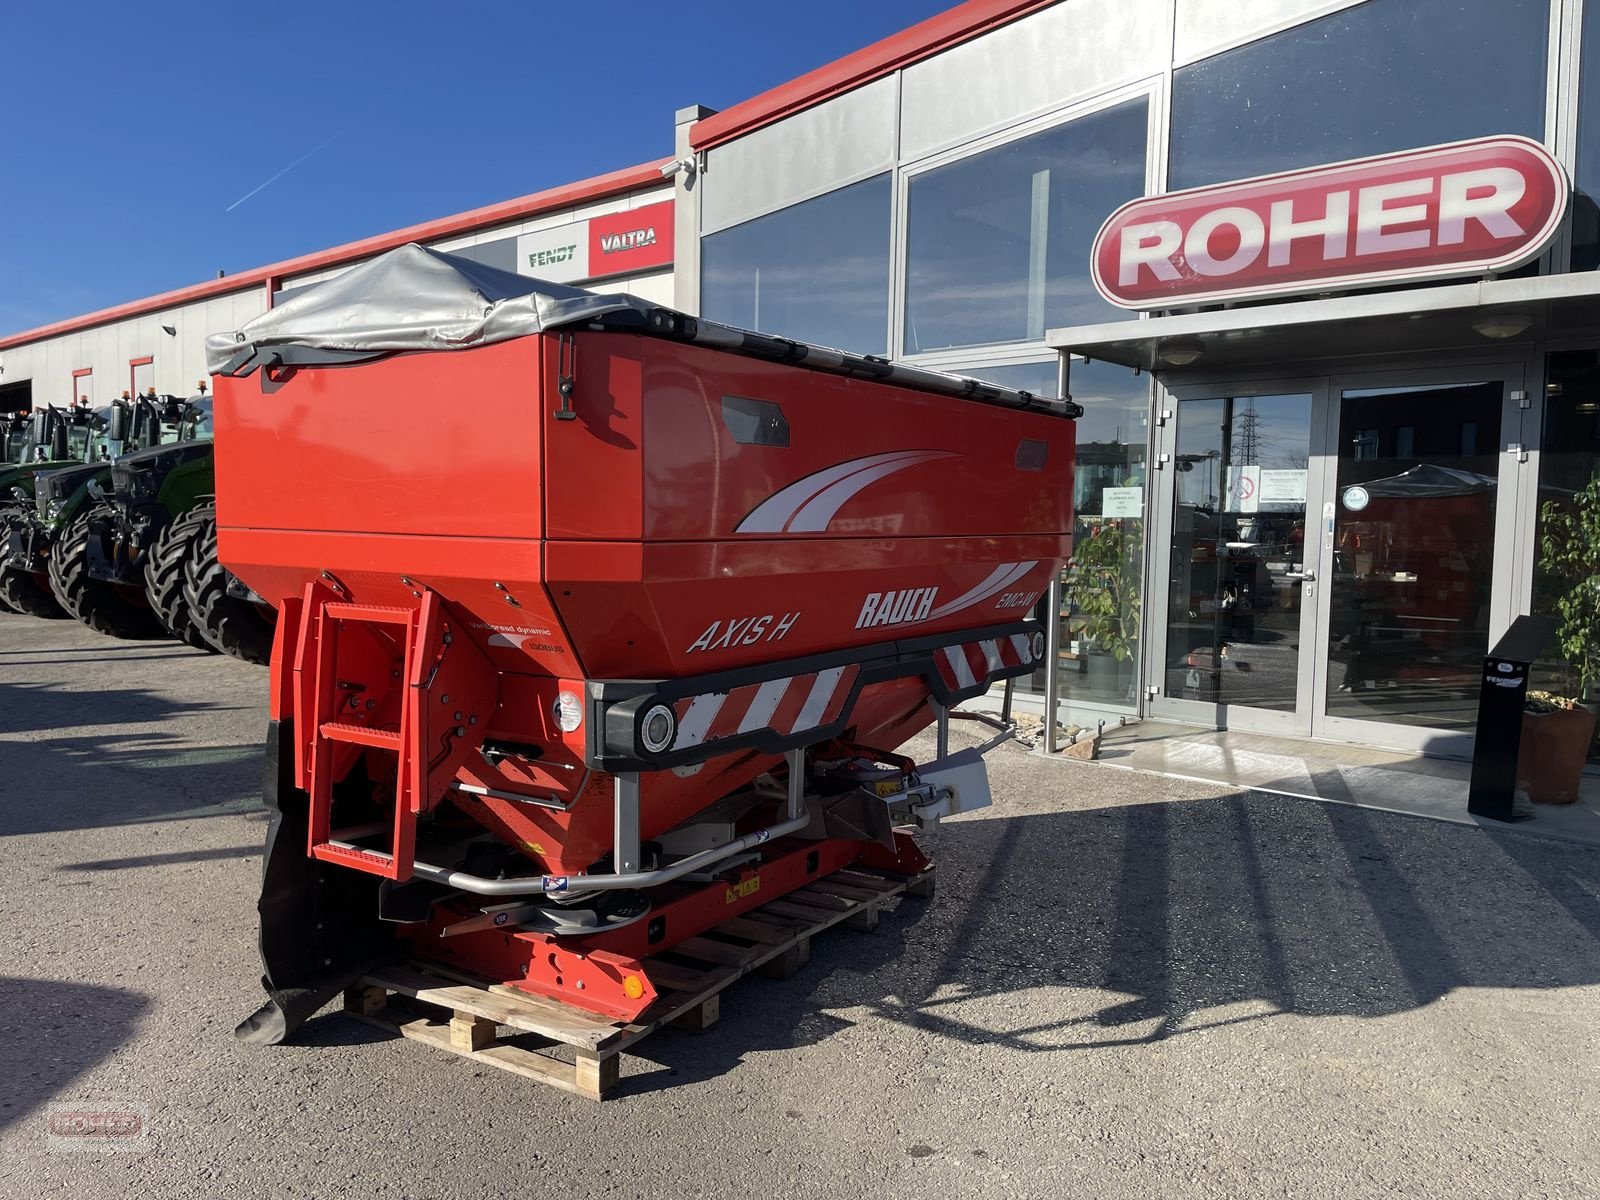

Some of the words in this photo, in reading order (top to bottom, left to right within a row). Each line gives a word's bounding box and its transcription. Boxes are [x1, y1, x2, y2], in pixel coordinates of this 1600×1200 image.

[600, 227, 656, 255] VALTRA
[1118, 166, 1527, 286] ROHER
[528, 244, 577, 268] FENDT
[855, 586, 939, 630] RAUCH
[516, 625, 552, 636] dynamic
[686, 614, 774, 654] AXIS
[769, 611, 801, 642] H
